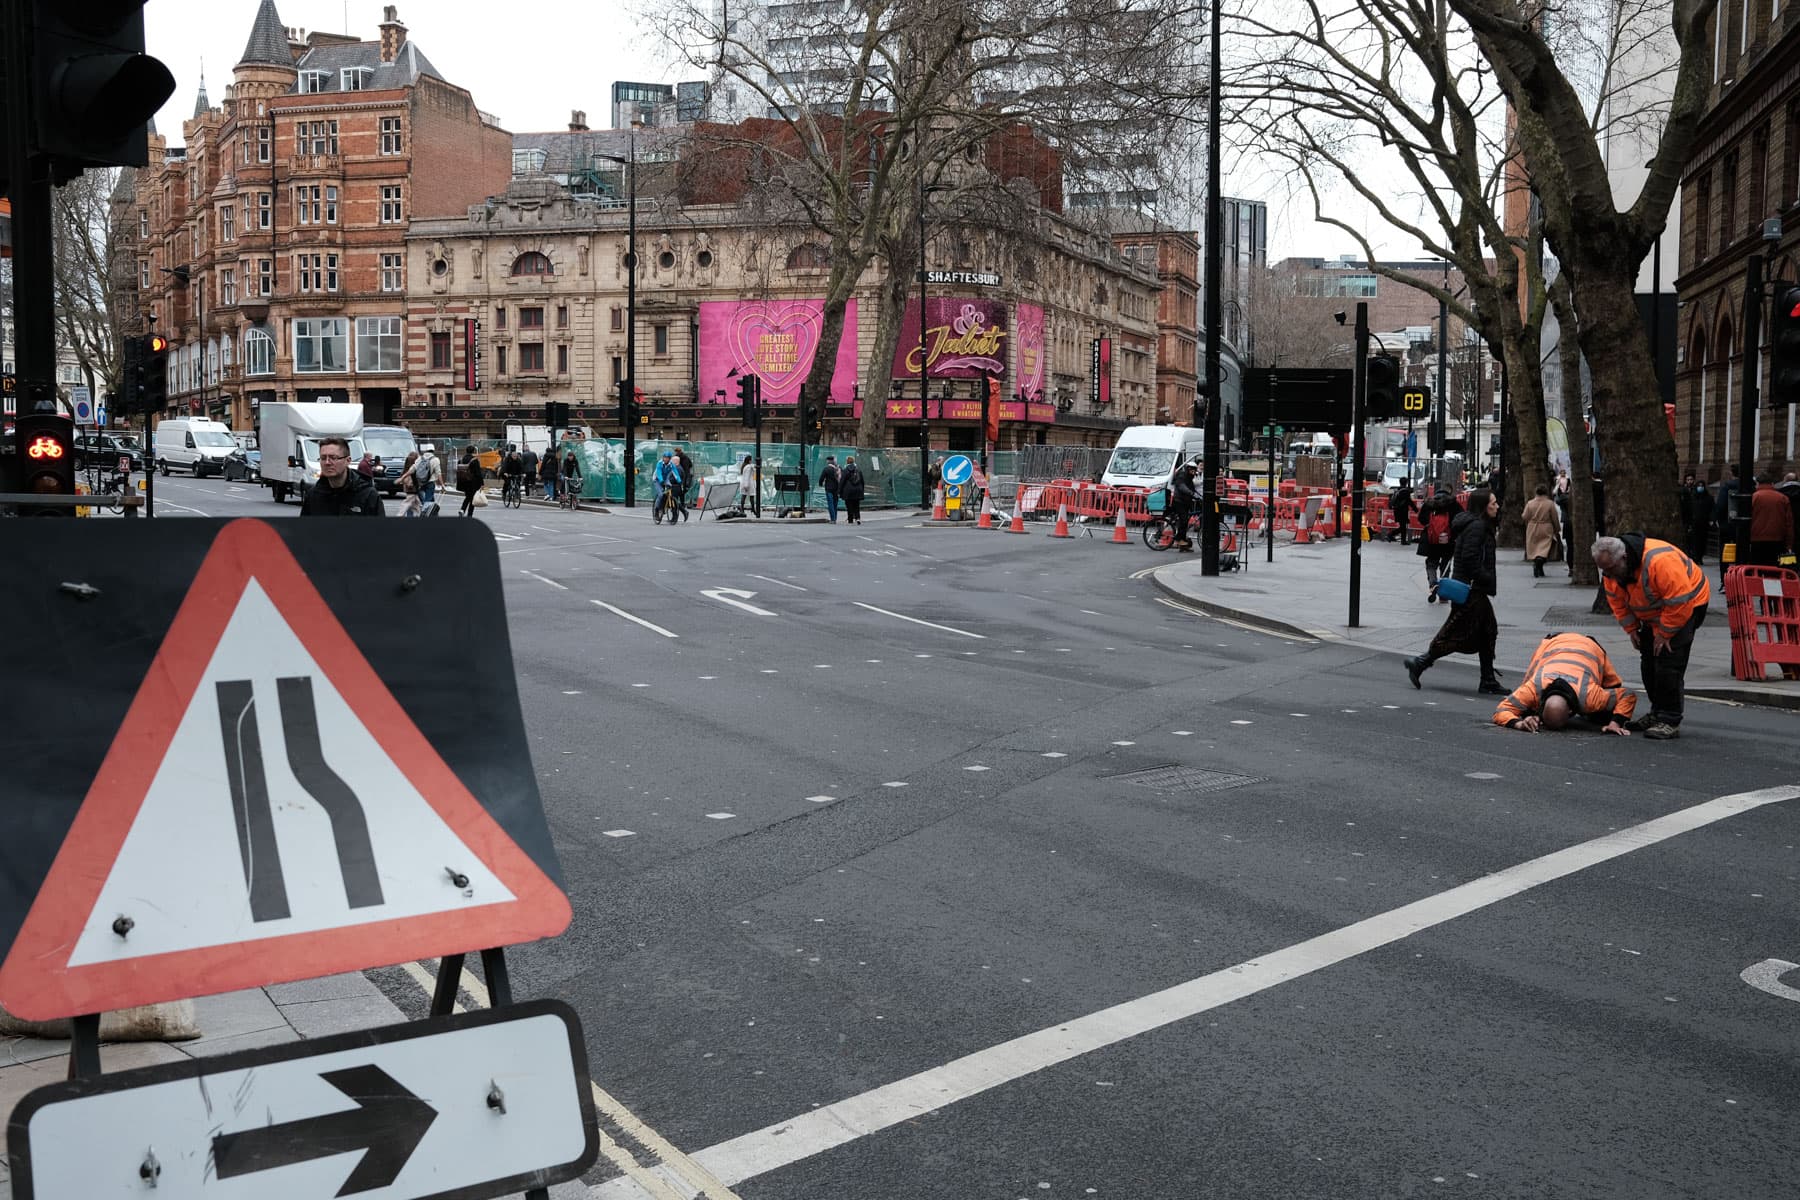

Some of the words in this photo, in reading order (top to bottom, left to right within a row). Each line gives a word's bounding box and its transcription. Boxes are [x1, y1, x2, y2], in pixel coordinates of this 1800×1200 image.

[928, 271, 999, 286] SHAFTESBURY
[953, 304, 985, 335] &
[760, 334, 794, 344] GREATEST
[756, 343, 774, 353] LOVE
[775, 343, 798, 353] STORY
[905, 322, 1007, 374] Juliet
[754, 353, 764, 363] OF
[765, 353, 779, 363] ALL
[780, 353, 798, 363] TIME
[1404, 393, 1424, 410] 03
